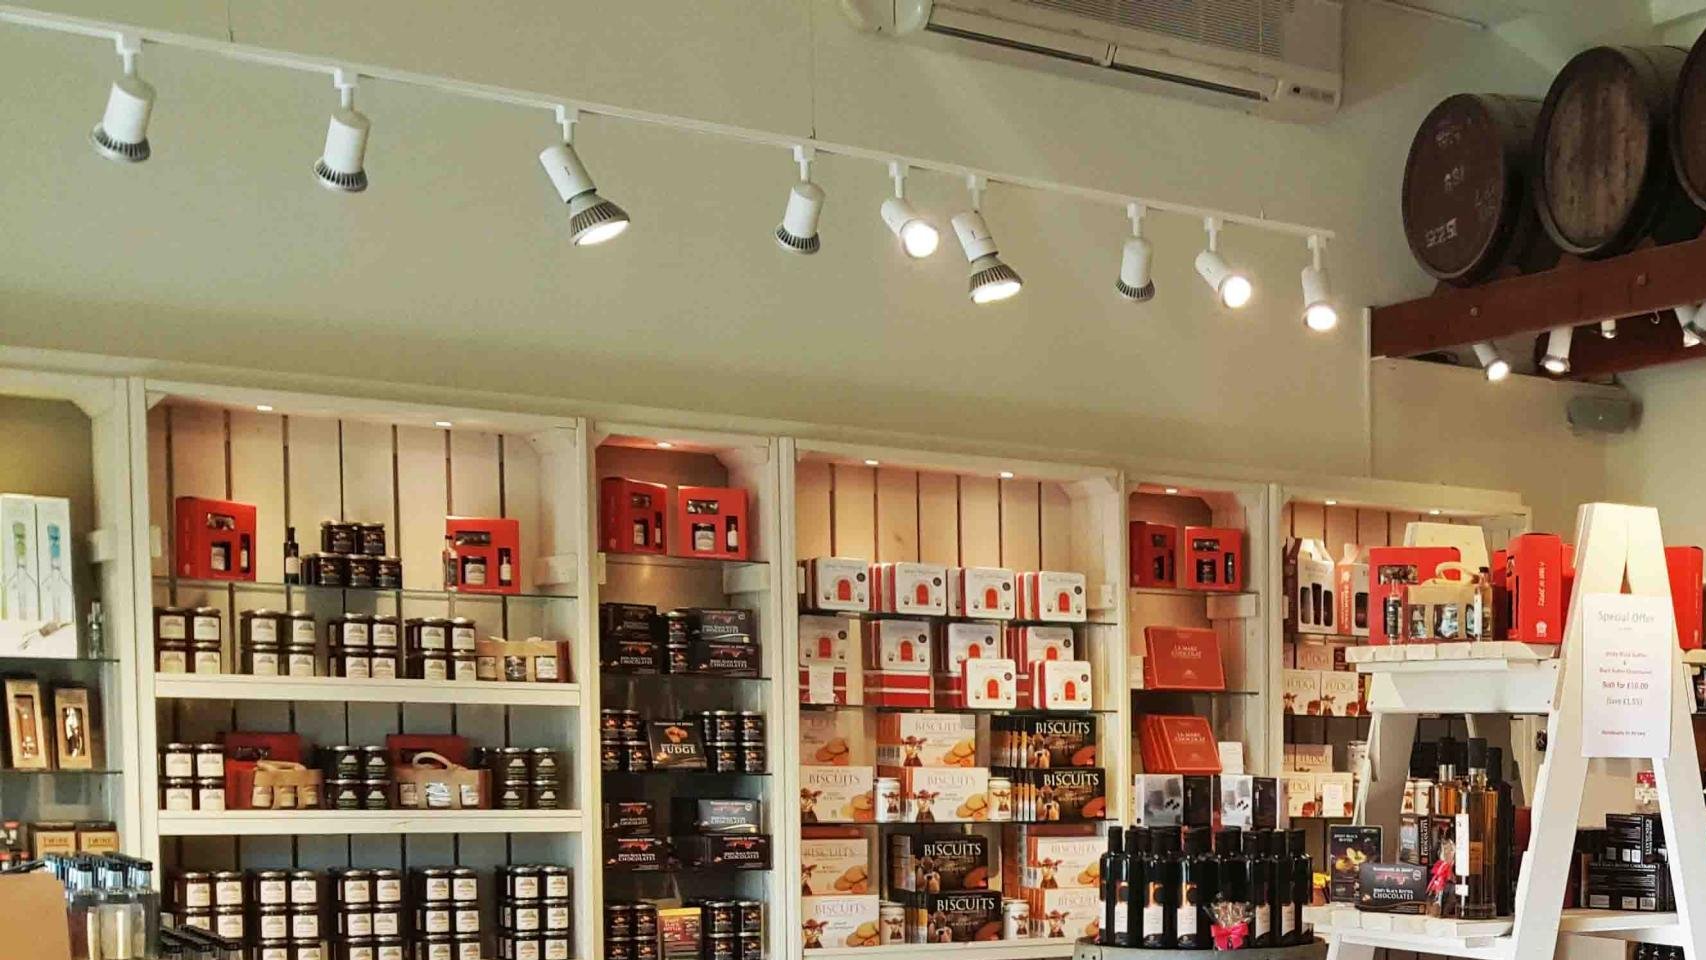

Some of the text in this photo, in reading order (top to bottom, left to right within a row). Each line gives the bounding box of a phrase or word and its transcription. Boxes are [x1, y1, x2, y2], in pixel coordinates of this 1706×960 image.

[1035, 721, 1090, 735] BISCUITS
[661, 744, 696, 754] FUDGE
[809, 774, 861, 785] BISCUITS
[1043, 773, 1100, 787] BISCUITS
[924, 842, 982, 857] BISCUITS
[1373, 892, 1414, 900] CHOCOLATES
[815, 903, 866, 915] BISCUITS
[937, 898, 995, 913] BISCUITS
